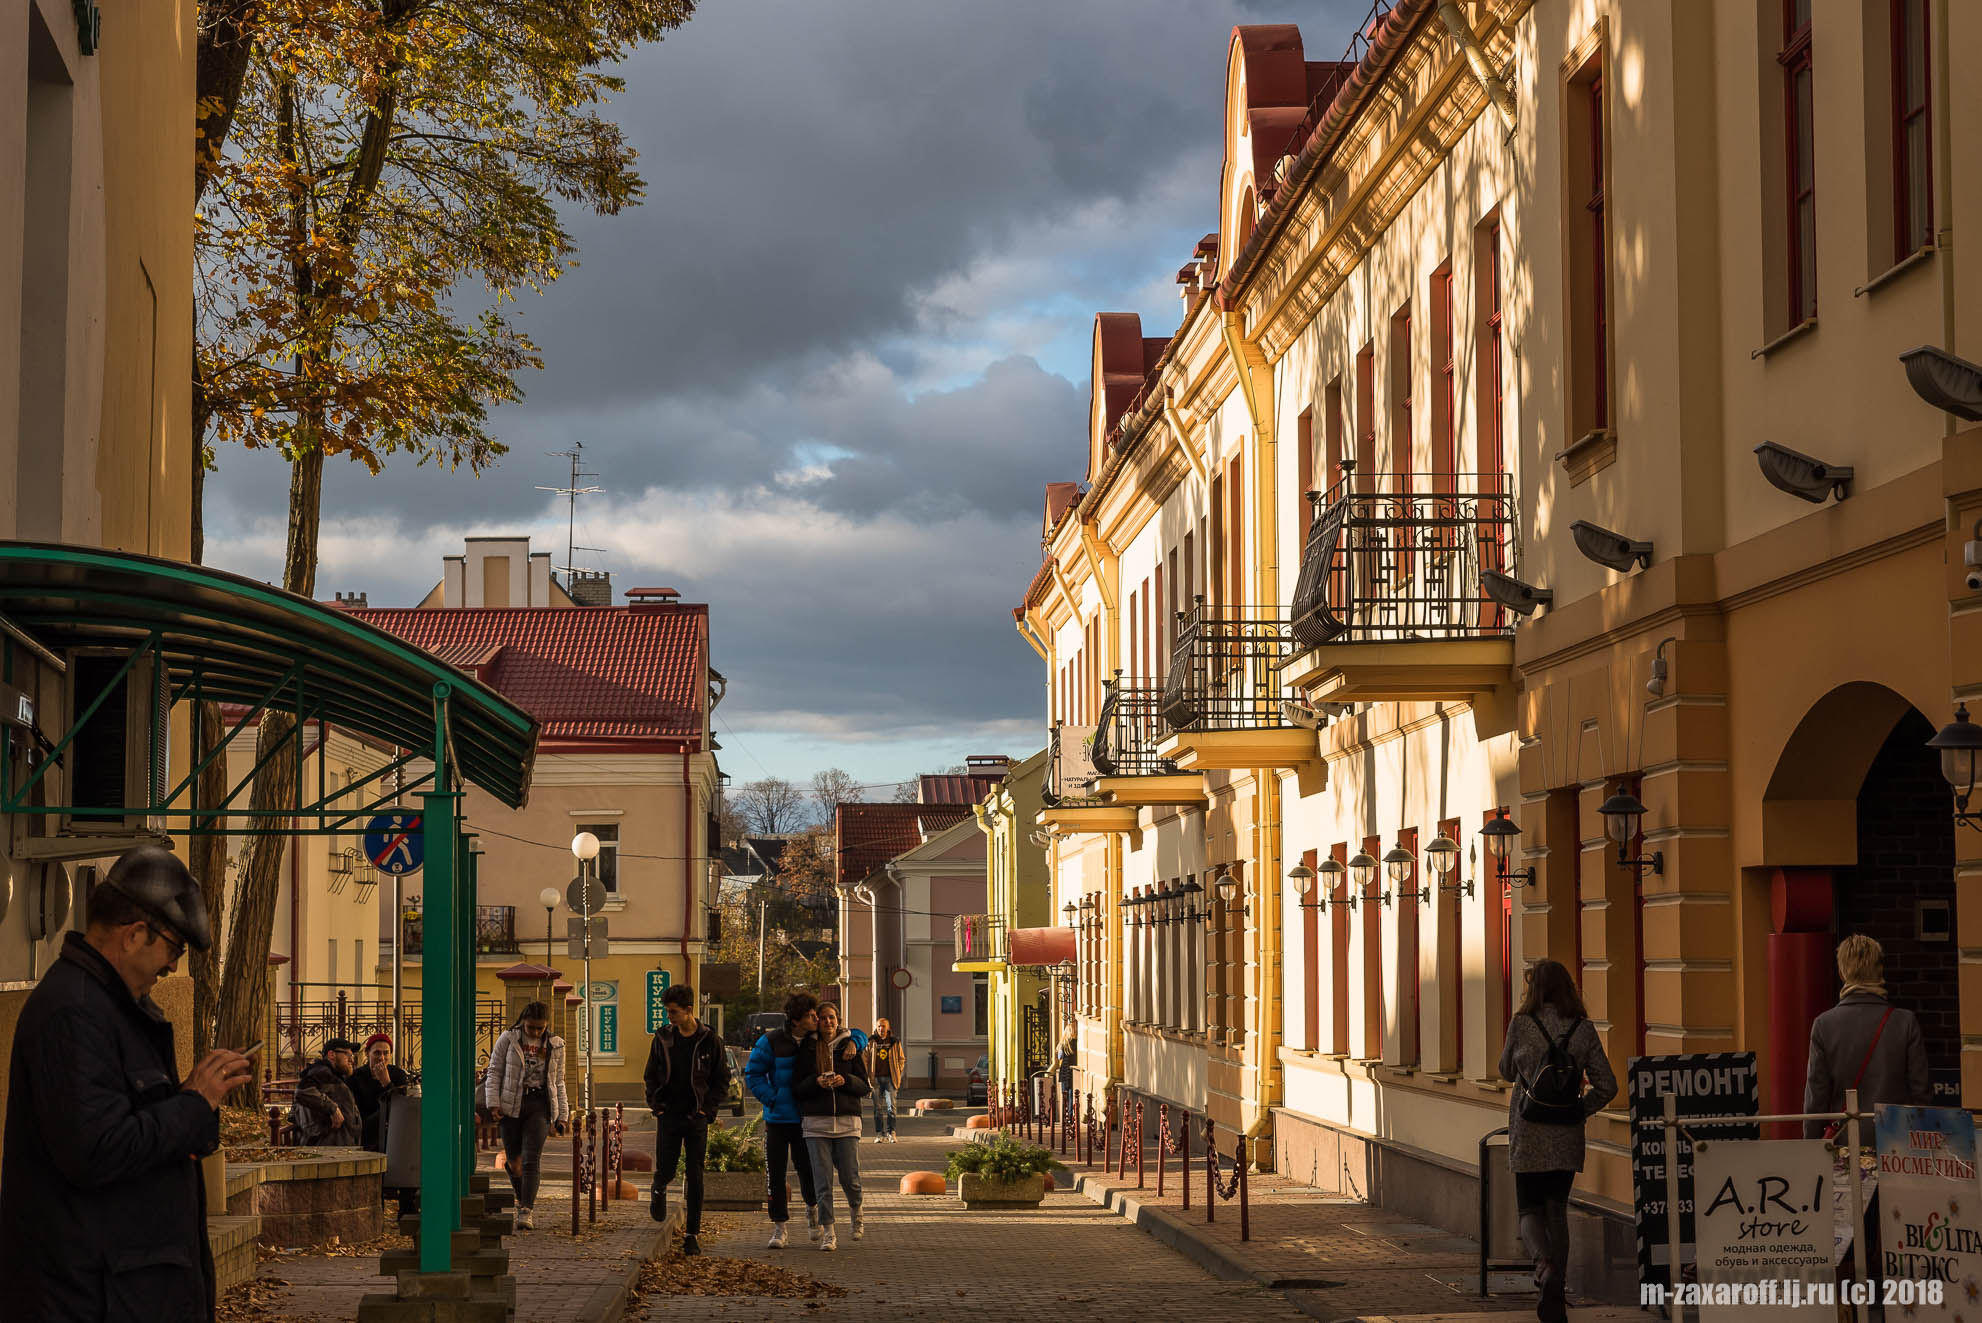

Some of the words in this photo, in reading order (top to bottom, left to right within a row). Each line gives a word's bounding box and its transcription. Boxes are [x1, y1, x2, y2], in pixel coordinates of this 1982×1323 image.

[652, 974, 664, 1031] КУХНИ
[603, 1007, 613, 1050] КУХНИ
[1638, 1067, 1749, 1099] РЕМОНТ
[1910, 1131, 1944, 1150] МИР
[1880, 1155, 1976, 1179] КОСМЕТИКИ
[1704, 1175, 1824, 1217] A.R.I
[1738, 1216, 1809, 1240] store
[1723, 1244, 1766, 1255] модная
[1769, 1243, 1817, 1253] одежда,
[1715, 1256, 1749, 1269] обувь
[1762, 1255, 1829, 1268] аксессуары
